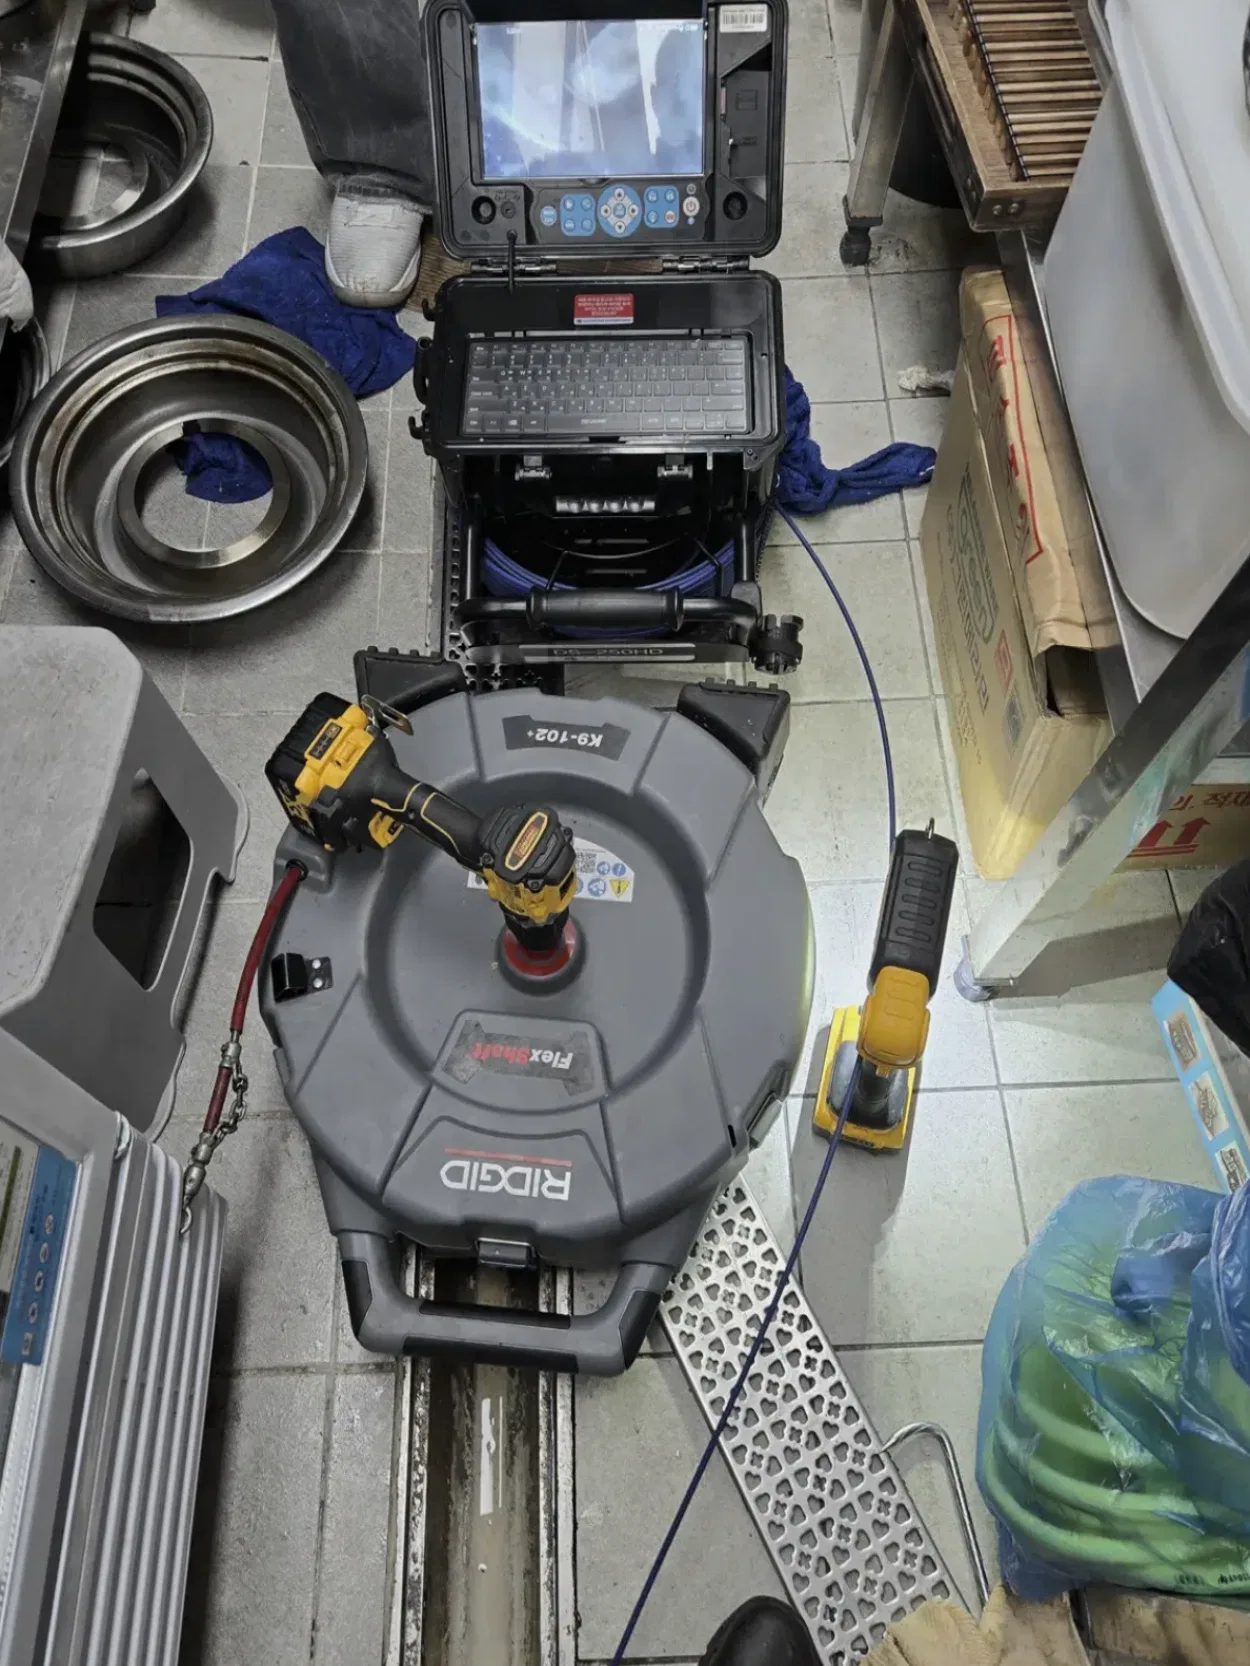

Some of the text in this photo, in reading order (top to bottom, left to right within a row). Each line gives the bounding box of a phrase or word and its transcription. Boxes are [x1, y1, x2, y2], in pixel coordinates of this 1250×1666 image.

[527, 728, 603, 748] K9-102+
[472, 1043, 573, 1069] FlexShaft
[440, 1160, 572, 1201] RIDGID
